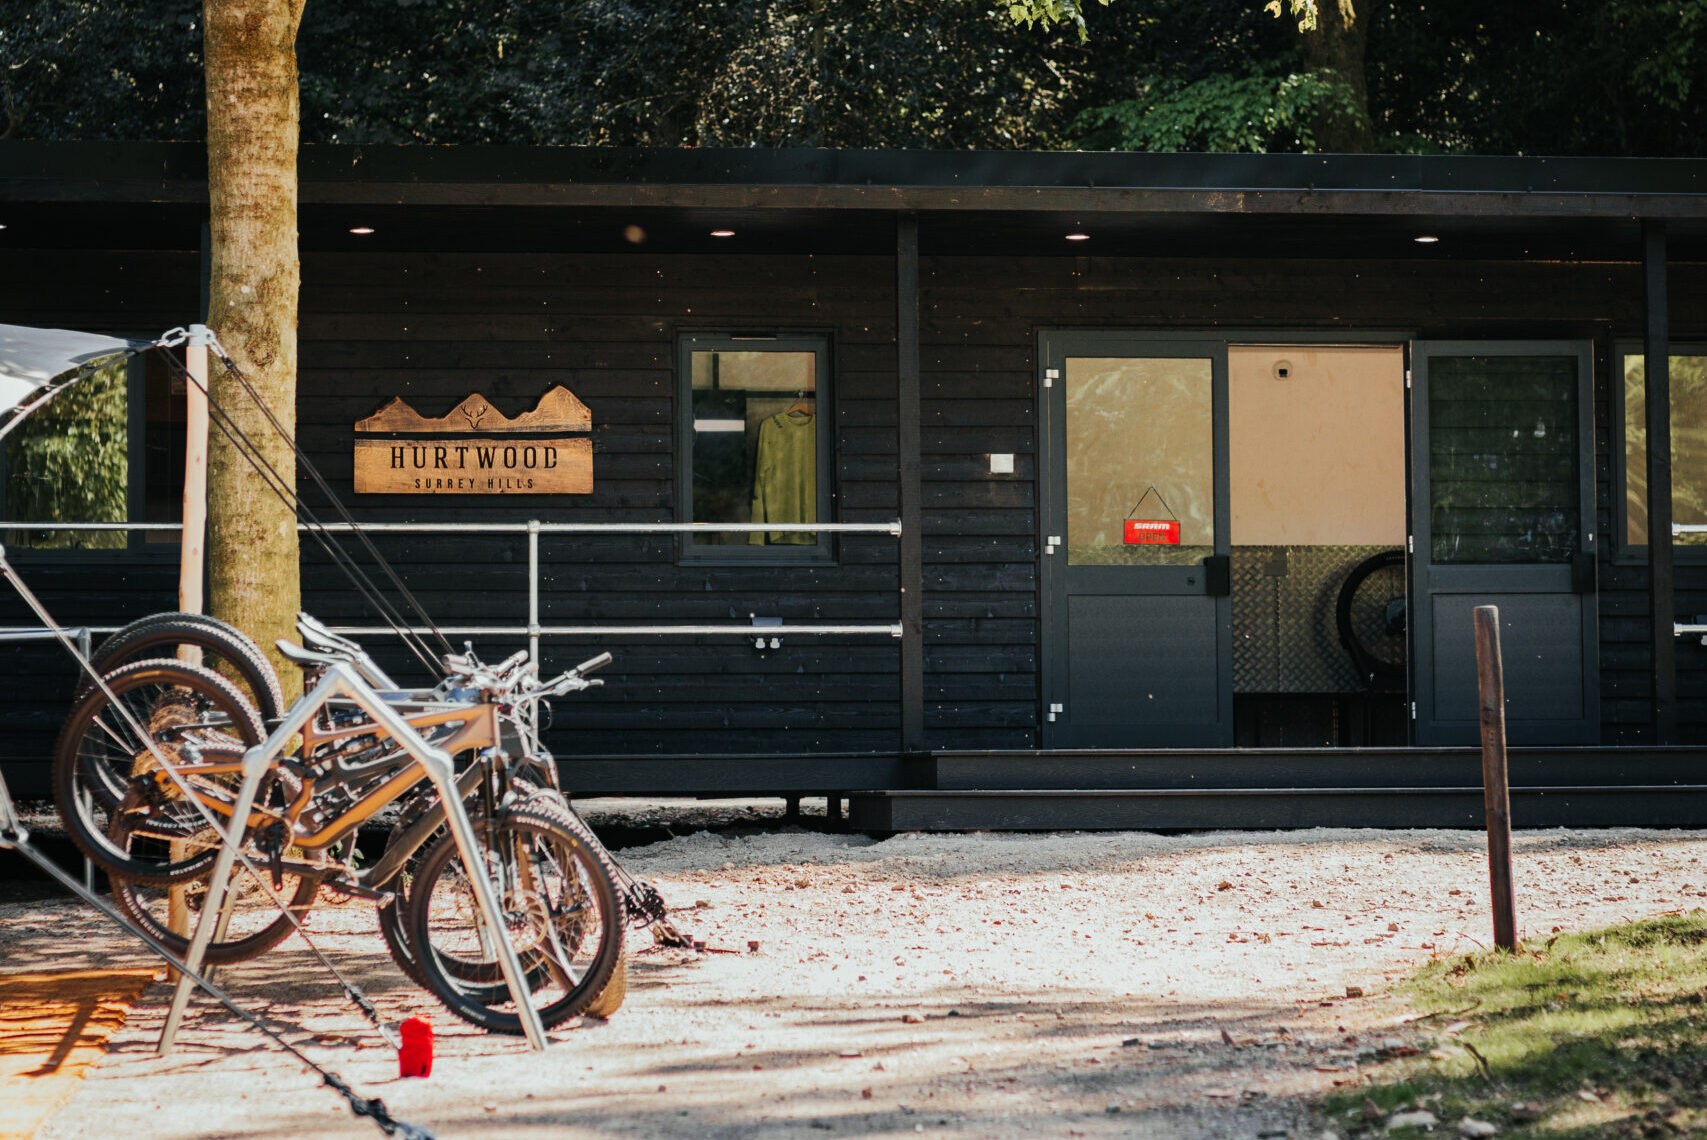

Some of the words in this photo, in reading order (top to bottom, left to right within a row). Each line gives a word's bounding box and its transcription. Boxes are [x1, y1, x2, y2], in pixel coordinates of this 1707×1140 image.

[391, 446, 558, 469] HURTWOOD
[415, 478, 475, 489] SURREY
[487, 478, 534, 489] HILLS
[1138, 532, 1166, 541] OPEN
